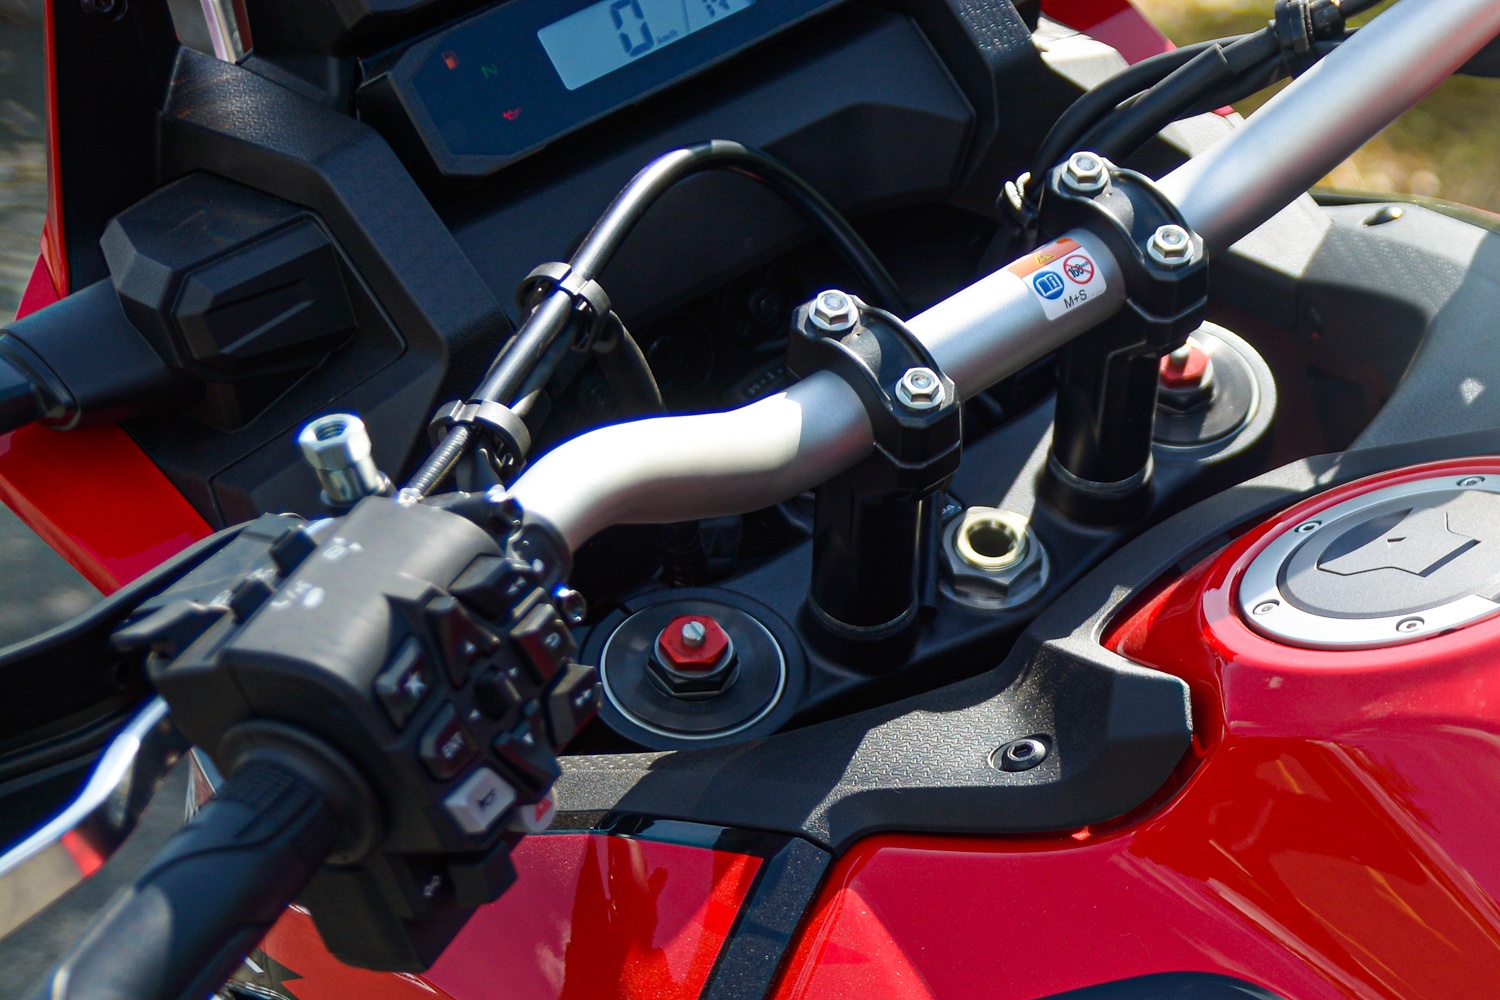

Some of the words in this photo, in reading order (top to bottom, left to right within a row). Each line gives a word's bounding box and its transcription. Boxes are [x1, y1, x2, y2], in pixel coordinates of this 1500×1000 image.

[609, 0, 655, 58] 0
[481, 62, 498, 79] N
[1063, 289, 1087, 309] M+S
